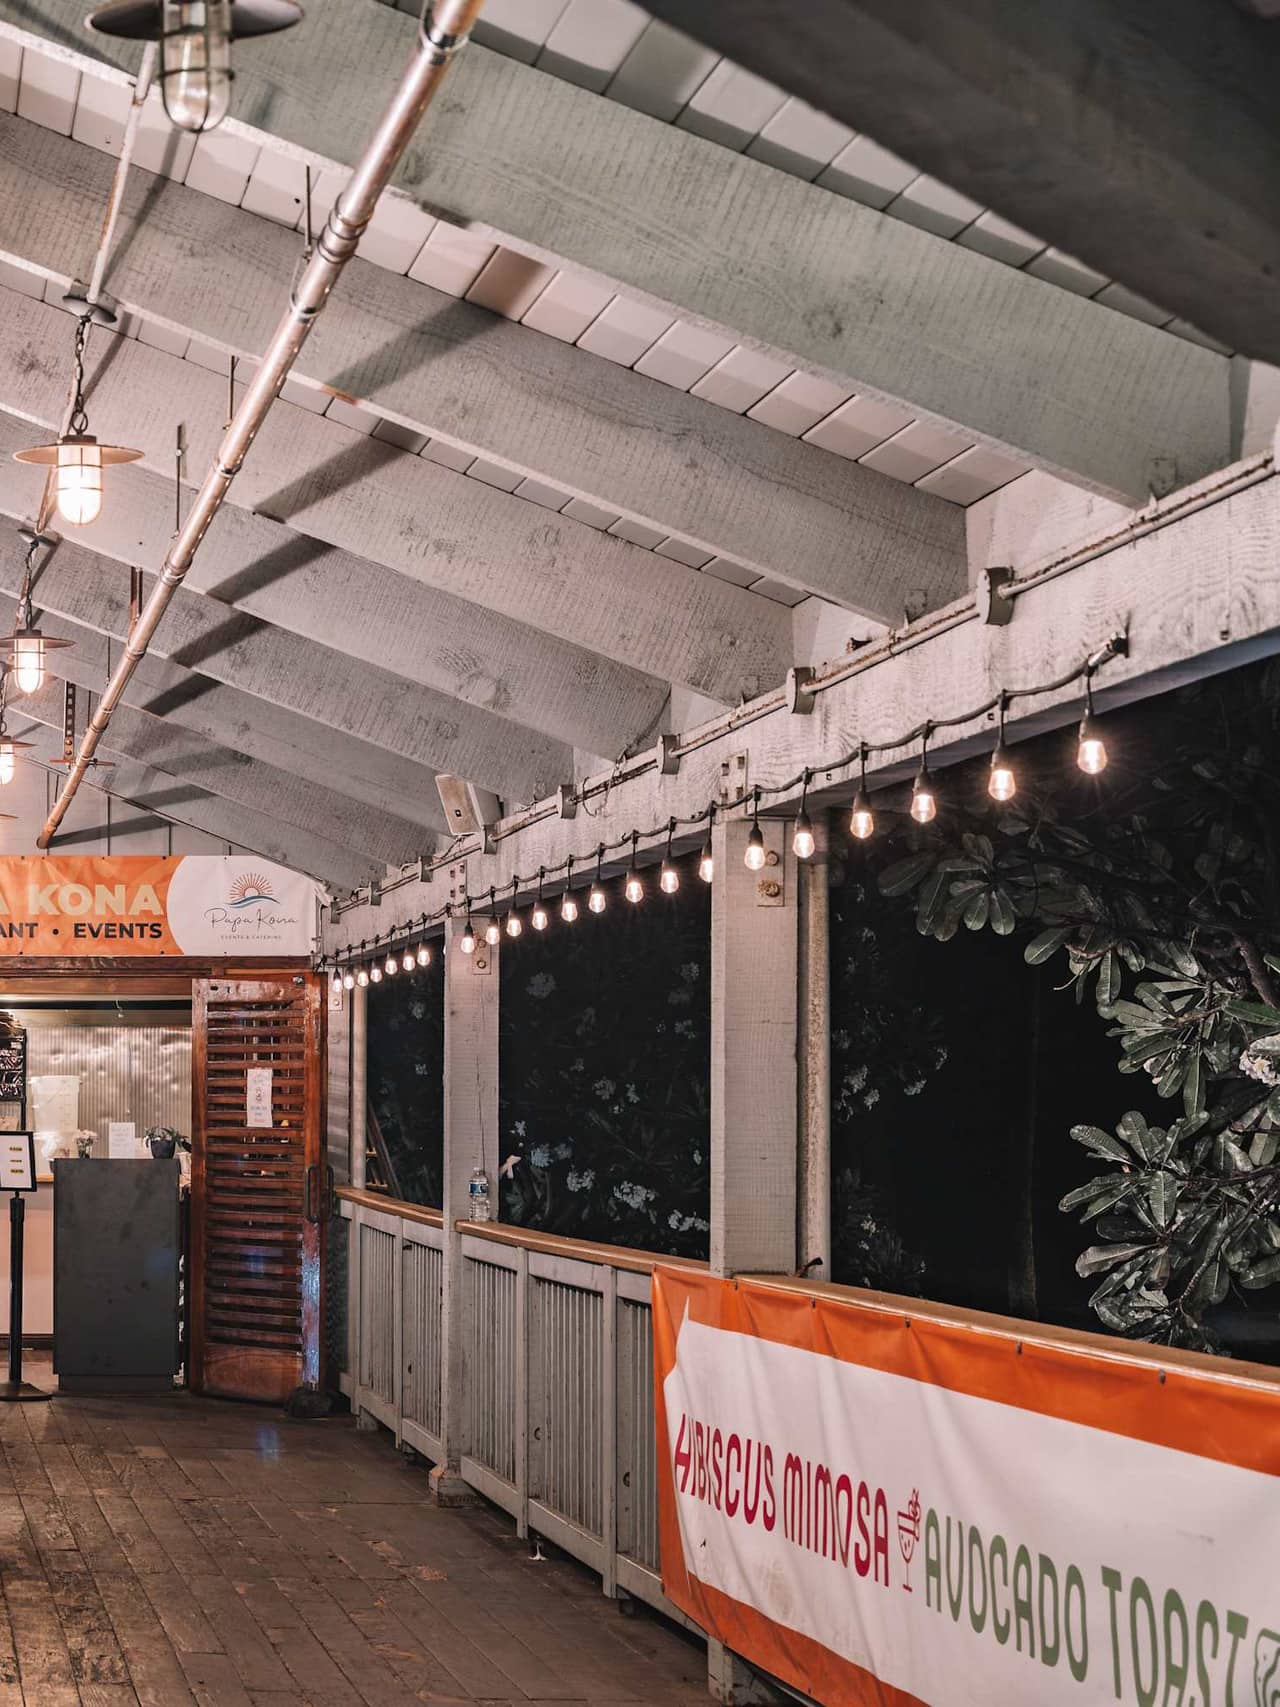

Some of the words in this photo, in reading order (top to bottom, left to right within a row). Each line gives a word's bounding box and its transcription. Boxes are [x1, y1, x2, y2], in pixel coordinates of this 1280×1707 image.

[27, 884, 164, 915] KONA
[73, 923, 162, 939] EVENTS
[204, 908, 254, 932] Papa
[674, 1412, 776, 1532] HIBISCUS
[783, 1452, 889, 1587] MIMOSA
[925, 1507, 1089, 1684] AVOCADO
[1100, 1564, 1249, 1707] TOAST
